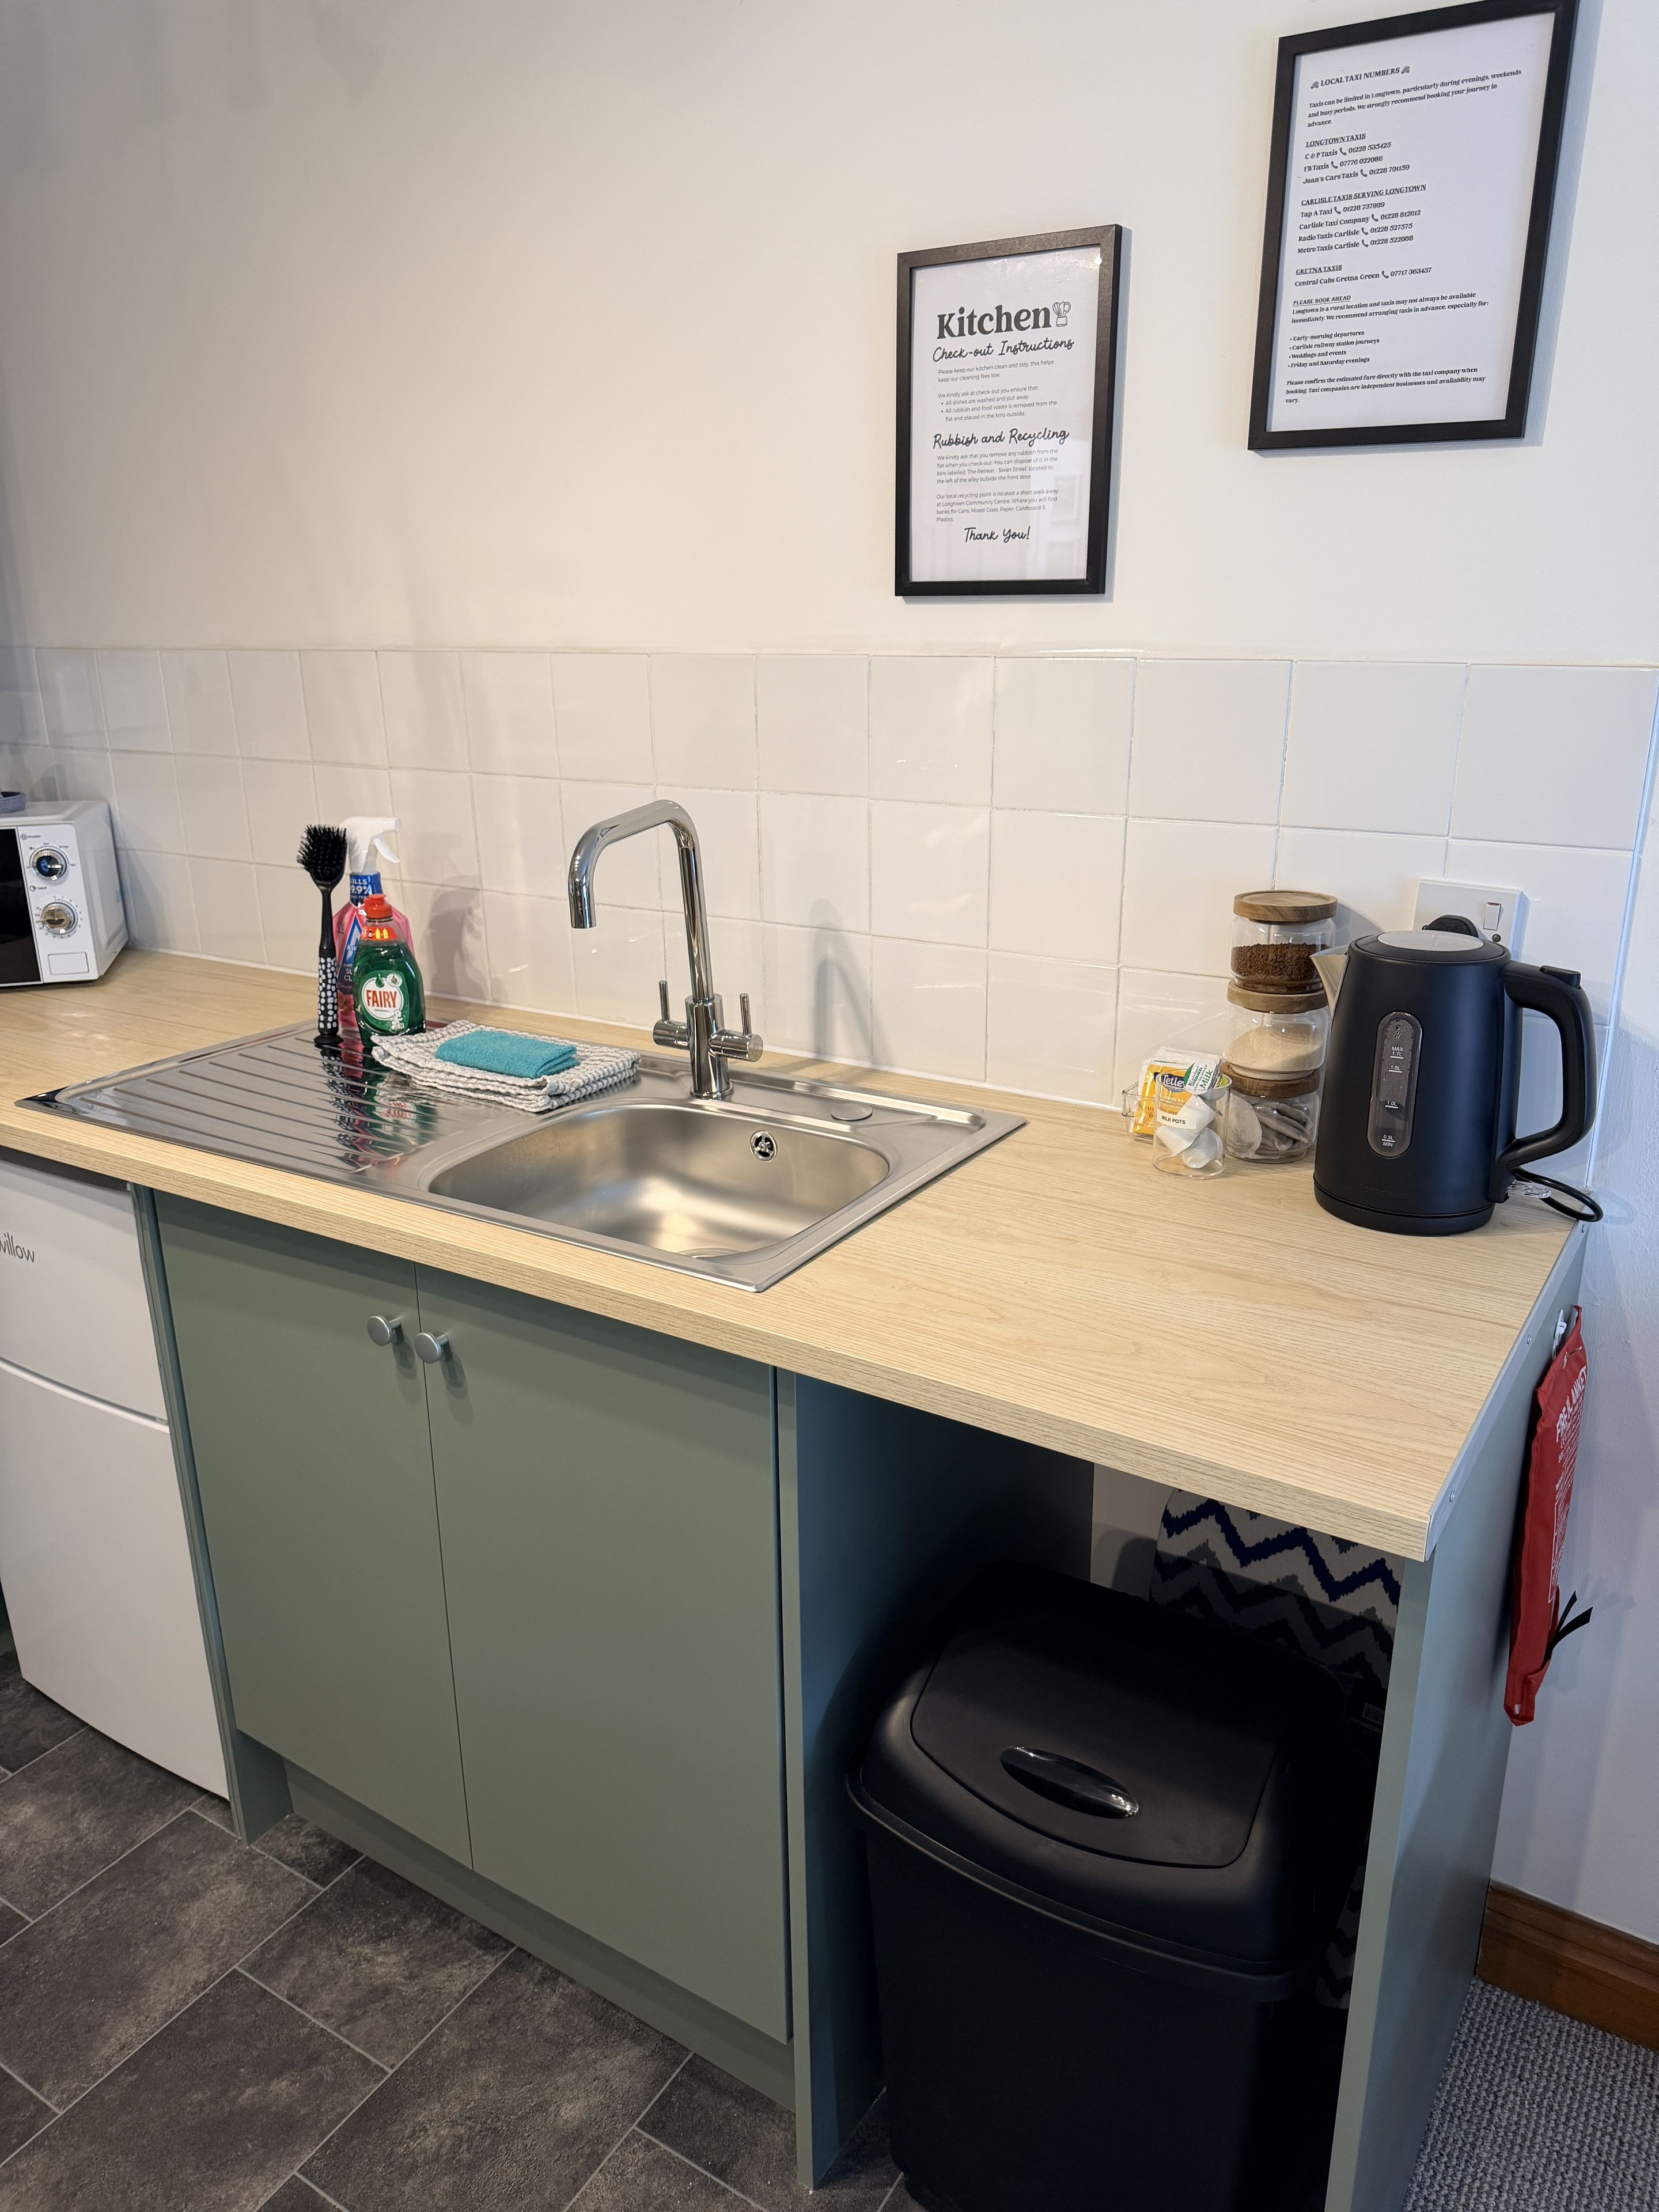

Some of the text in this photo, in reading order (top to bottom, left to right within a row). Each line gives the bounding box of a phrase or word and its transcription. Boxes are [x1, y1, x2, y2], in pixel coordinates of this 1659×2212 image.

[1320, 67, 1400, 86] LOCAL TAXI NUMBERS
[1343, 94, 1364, 103] limited
[1402, 82, 1440, 94] particularly
[1440, 79, 1461, 88] during
[1491, 69, 1522, 79] weekends
[1366, 100, 1391, 109] strongly
[1391, 94, 1426, 105] recommend
[1426, 90, 1450, 100] booking
[1450, 89, 1466, 97] your
[1465, 85, 1491, 95] journey
[1305, 133, 1366, 148] LONGTOWN TAXIS
[1320, 149, 1338, 158] Taxis
[1348, 145, 1367, 154] 01228
[1302, 176, 1324, 184] Joan's
[1341, 171, 1359, 179] Taxis
[1369, 167, 1388, 176] 01228
[1388, 164, 1410, 173] 791159
[1312, 162, 1330, 171] Taxis
[1339, 159, 1358, 167] 07776
[1301, 184, 1427, 206] CARLISLE TAXIS SERVING LONGTOWN
[1319, 207, 1333, 215] Taxi
[1343, 204, 1361, 213] 01228
[1299, 209, 1421, 230] Carlisle Taxi Company 01228 812612
[1298, 234, 1316, 242] Radio
[1316, 232, 1334, 240] Taxis
[1334, 229, 1360, 238] Carlisle
[1389, 222, 1414, 232] 527575
[1316, 244, 1334, 252] Taxis
[1334, 241, 1360, 250] Carlisle
[1370, 238, 1389, 246] 01228
[1389, 235, 1414, 244] 522088
[1295, 264, 1343, 276] GRETNA TAXIS
[1294, 278, 1319, 287] Central
[1335, 311, 1368, 320] recommend
[1368, 308, 1399, 317] arranging
[1447, 301, 1478, 310] especially
[1346, 302, 1368, 310] location
[1448, 292, 1476, 300] available
[936, 304, 1052, 340] Kitchen
[1334, 331, 1365, 339] departures
[933, 337, 1075, 362] Check-out Instructions
[933, 427, 1070, 449] Rubbish and Recycling
[964, 525, 1031, 544] Thank You!
[366, 990, 397, 1008] FAIRY
[1163, 1074, 1184, 1088] Tetle
[1199, 1069, 1213, 1089] Milk
[1556, 1406, 1567, 1443] FIRE
